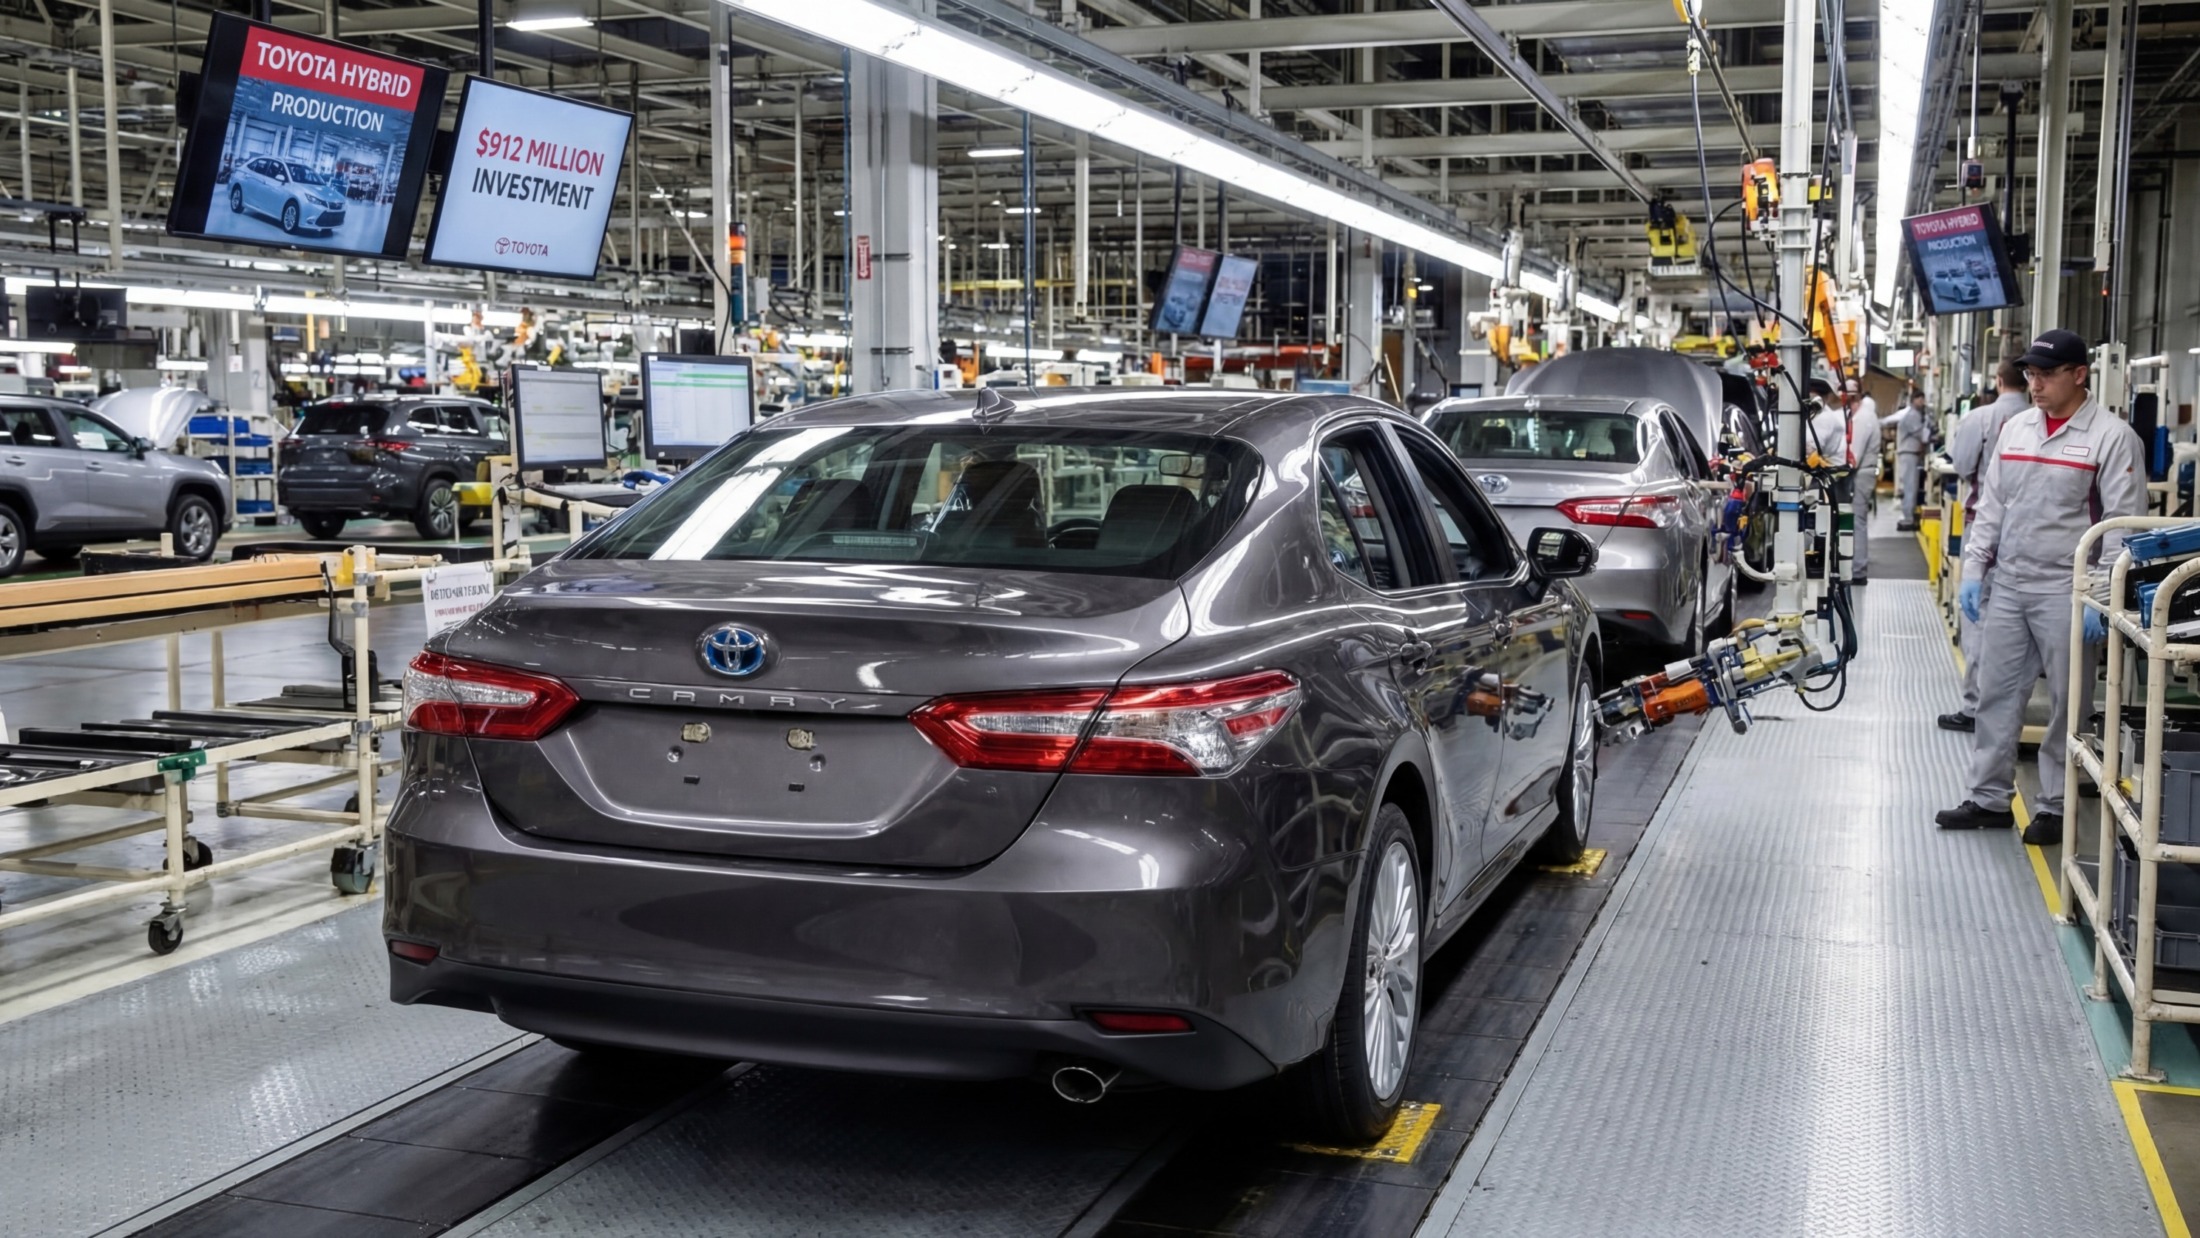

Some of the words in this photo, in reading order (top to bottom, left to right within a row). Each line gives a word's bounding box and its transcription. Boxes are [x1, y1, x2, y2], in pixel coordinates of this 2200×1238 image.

[257, 41, 336, 82] TOYOTA
[341, 62, 411, 98] HYBRID
[271, 91, 385, 132] PRODUCTION
[476, 127, 524, 162] $912
[526, 139, 605, 177] MILLION
[472, 167, 595, 210] INVESTMENT
[1914, 219, 1947, 235] TOYOTA
[511, 240, 549, 257] TOYOTA
[629, 688, 846, 709] CAMRY
